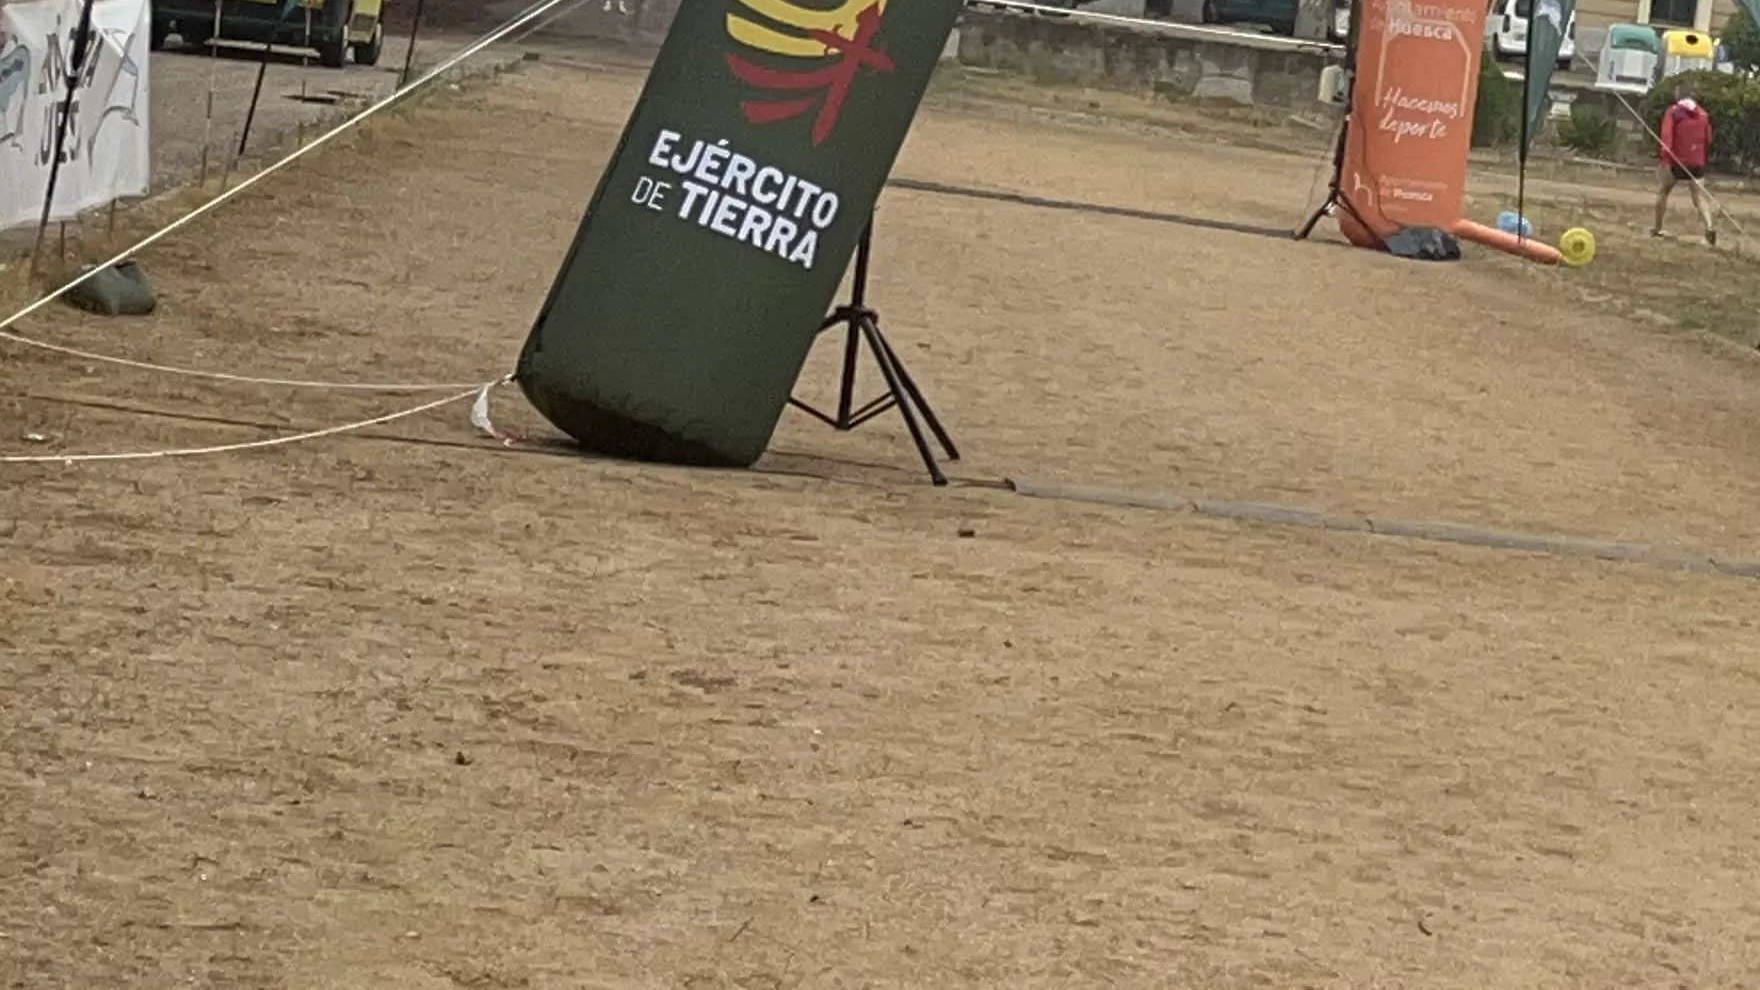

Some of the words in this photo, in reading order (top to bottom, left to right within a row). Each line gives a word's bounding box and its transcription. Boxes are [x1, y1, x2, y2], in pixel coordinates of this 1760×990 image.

[631, 175, 672, 211] DE
[678, 180, 818, 270] TIERRA
[648, 128, 839, 229] EJÉRCITO
